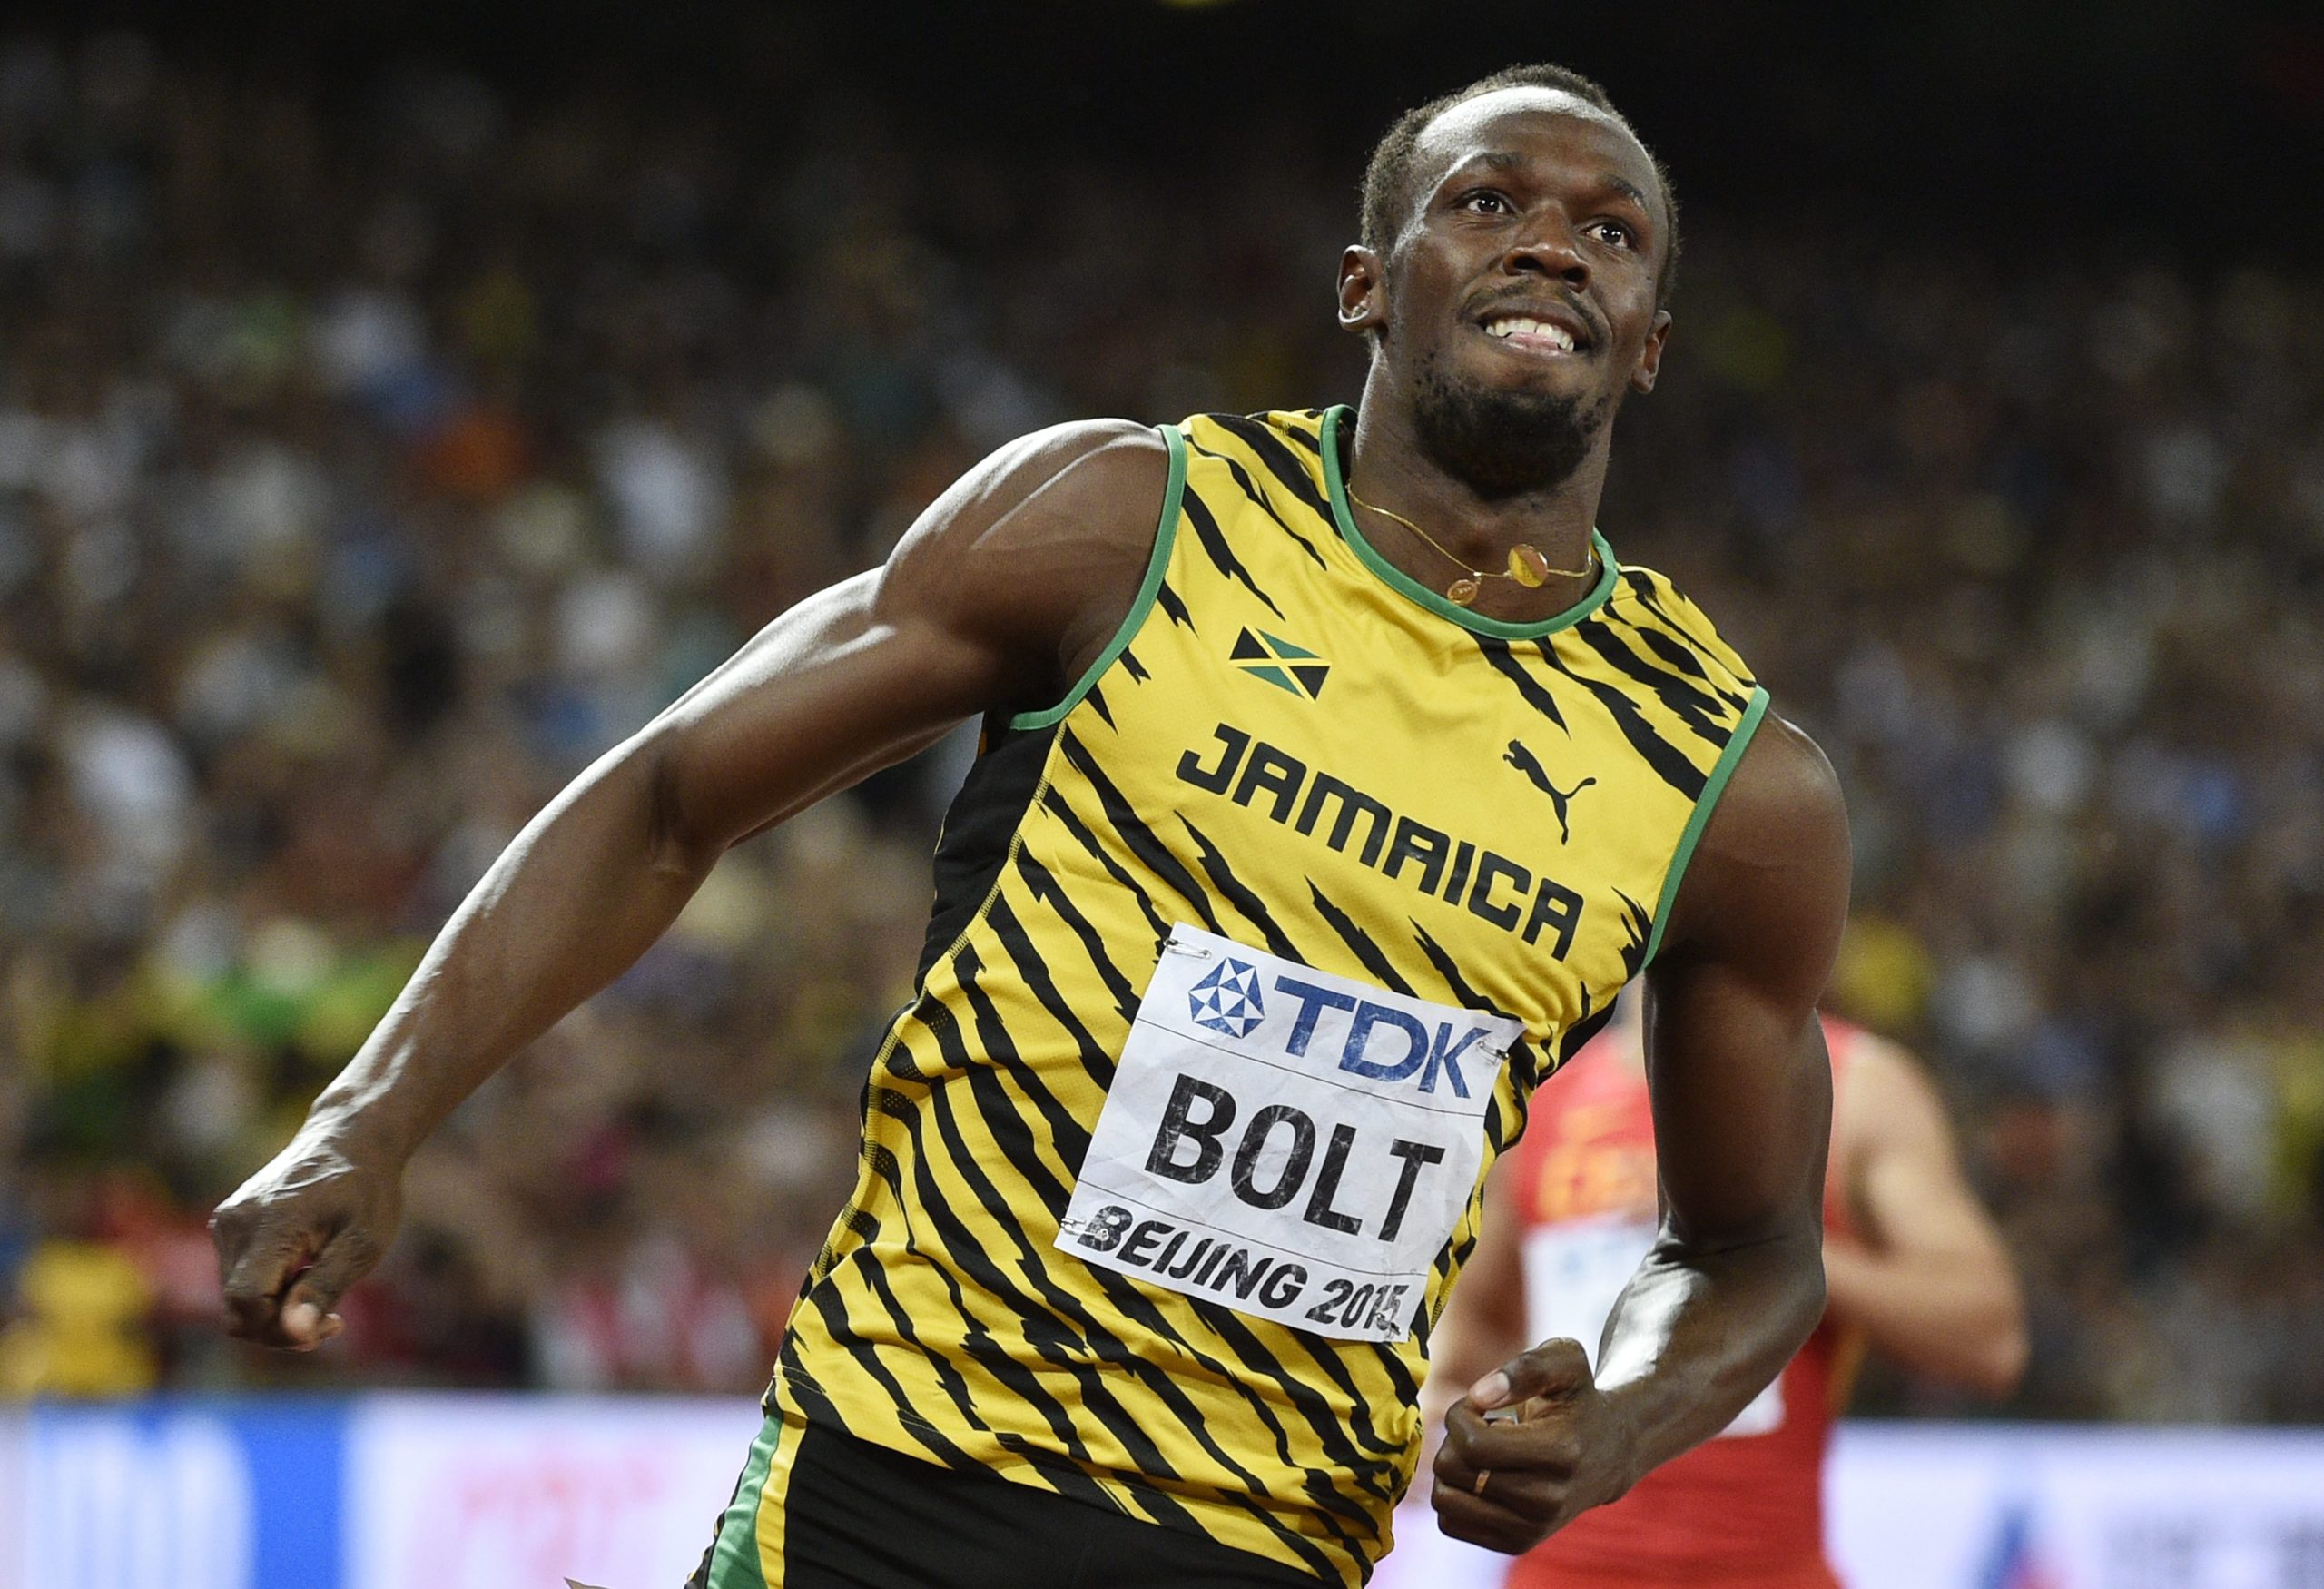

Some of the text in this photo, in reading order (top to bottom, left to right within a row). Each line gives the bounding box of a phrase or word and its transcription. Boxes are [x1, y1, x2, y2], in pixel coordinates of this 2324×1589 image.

[1176, 723, 1584, 962] JAMAICA
[1274, 975, 1492, 1099] TDK
[1144, 1073, 1445, 1243] BOLT
[1077, 1205, 1409, 1331] BEIJING 2015
